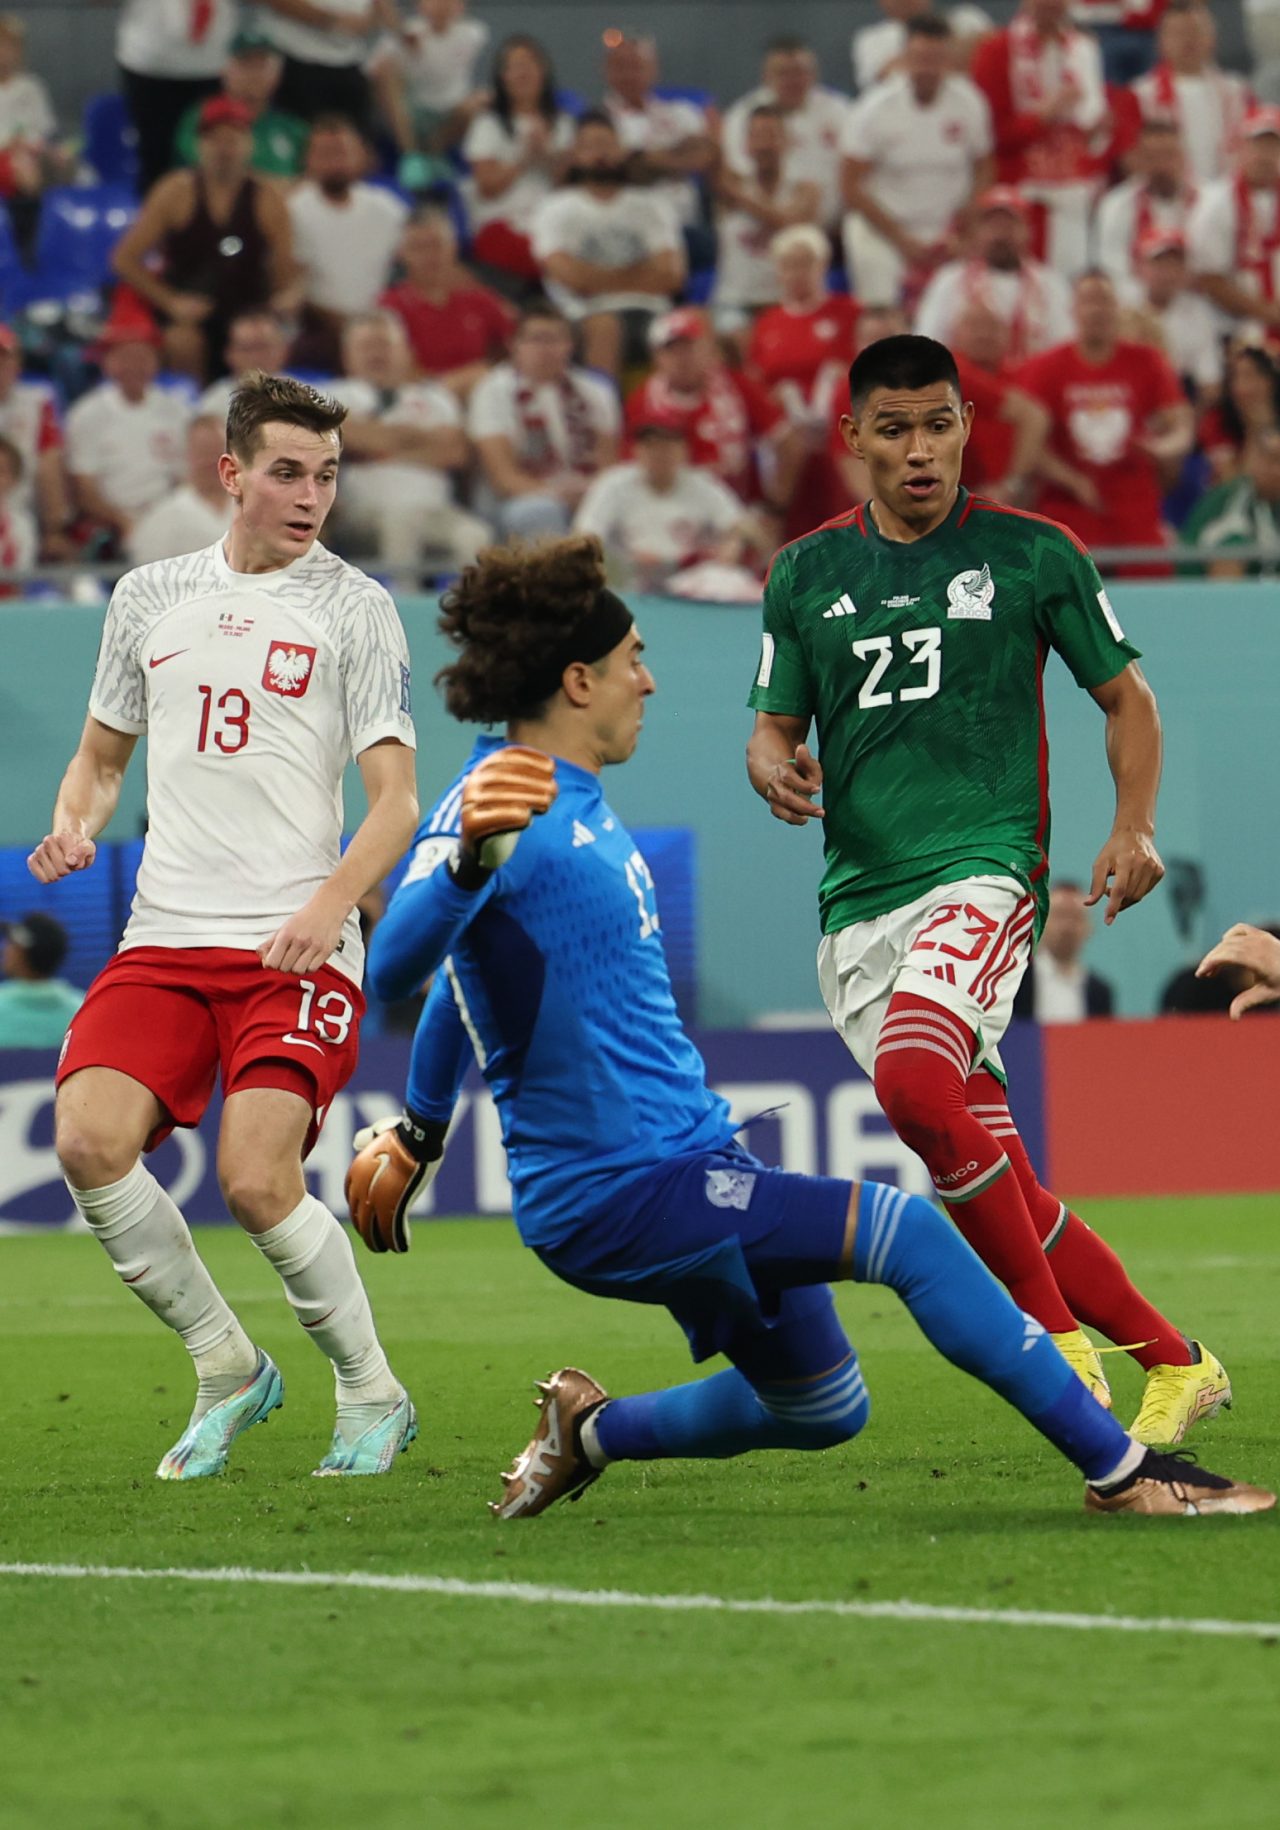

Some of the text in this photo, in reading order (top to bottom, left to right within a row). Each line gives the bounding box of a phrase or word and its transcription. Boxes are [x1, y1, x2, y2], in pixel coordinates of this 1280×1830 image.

[852, 627, 942, 709] 23
[197, 684, 250, 753] 13
[911, 902, 999, 961] 23
[297, 980, 352, 1045] 13
